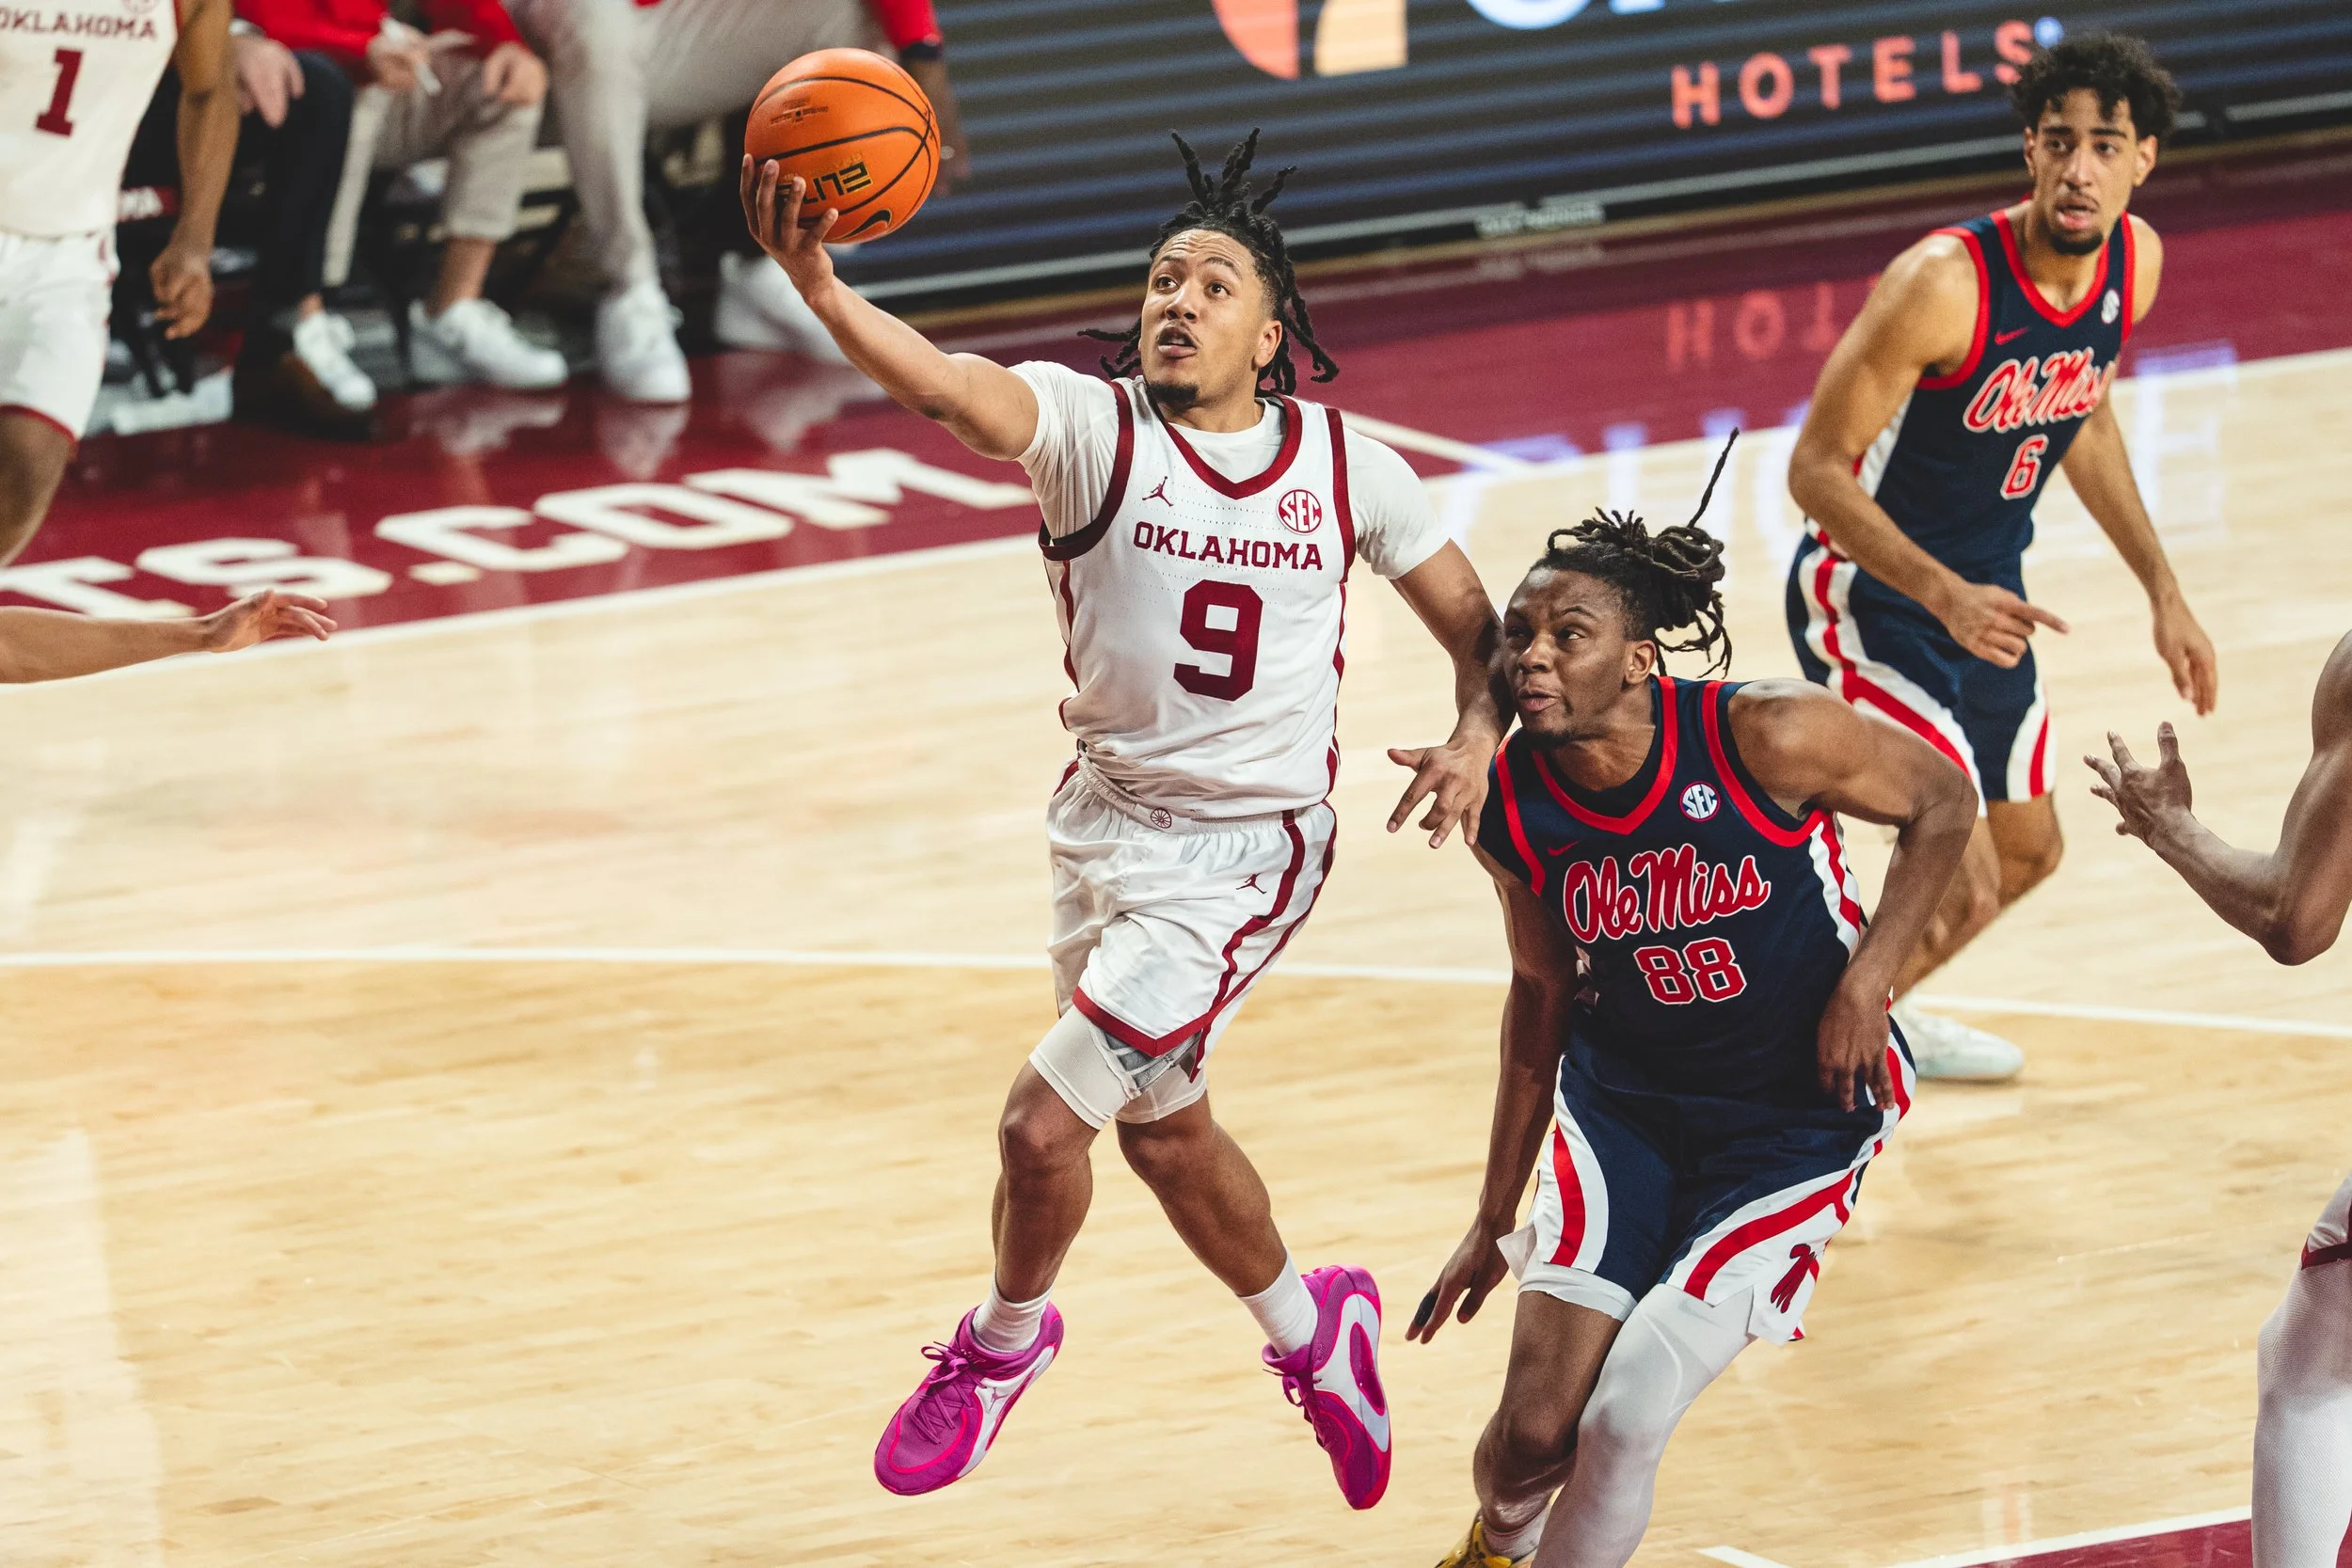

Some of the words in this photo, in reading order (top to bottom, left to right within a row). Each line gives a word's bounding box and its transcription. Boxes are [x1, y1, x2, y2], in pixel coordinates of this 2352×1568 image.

[0, 7, 157, 40] OKLAHOMA
[36, 48, 84, 136] 1
[1671, 19, 2032, 129] HOTELS
[1963, 356, 2040, 434] Ole
[2000, 434, 2049, 500] 6
[1279, 489, 1322, 531] SEC
[1133, 520, 1324, 571] OKLAHOMA
[1173, 579, 1263, 702] 9
[1682, 784, 1719, 819] SEC
[1563, 855, 1643, 942] Ole
[1629, 843, 1772, 932] Miss
[1633, 937, 1748, 1006] 88
